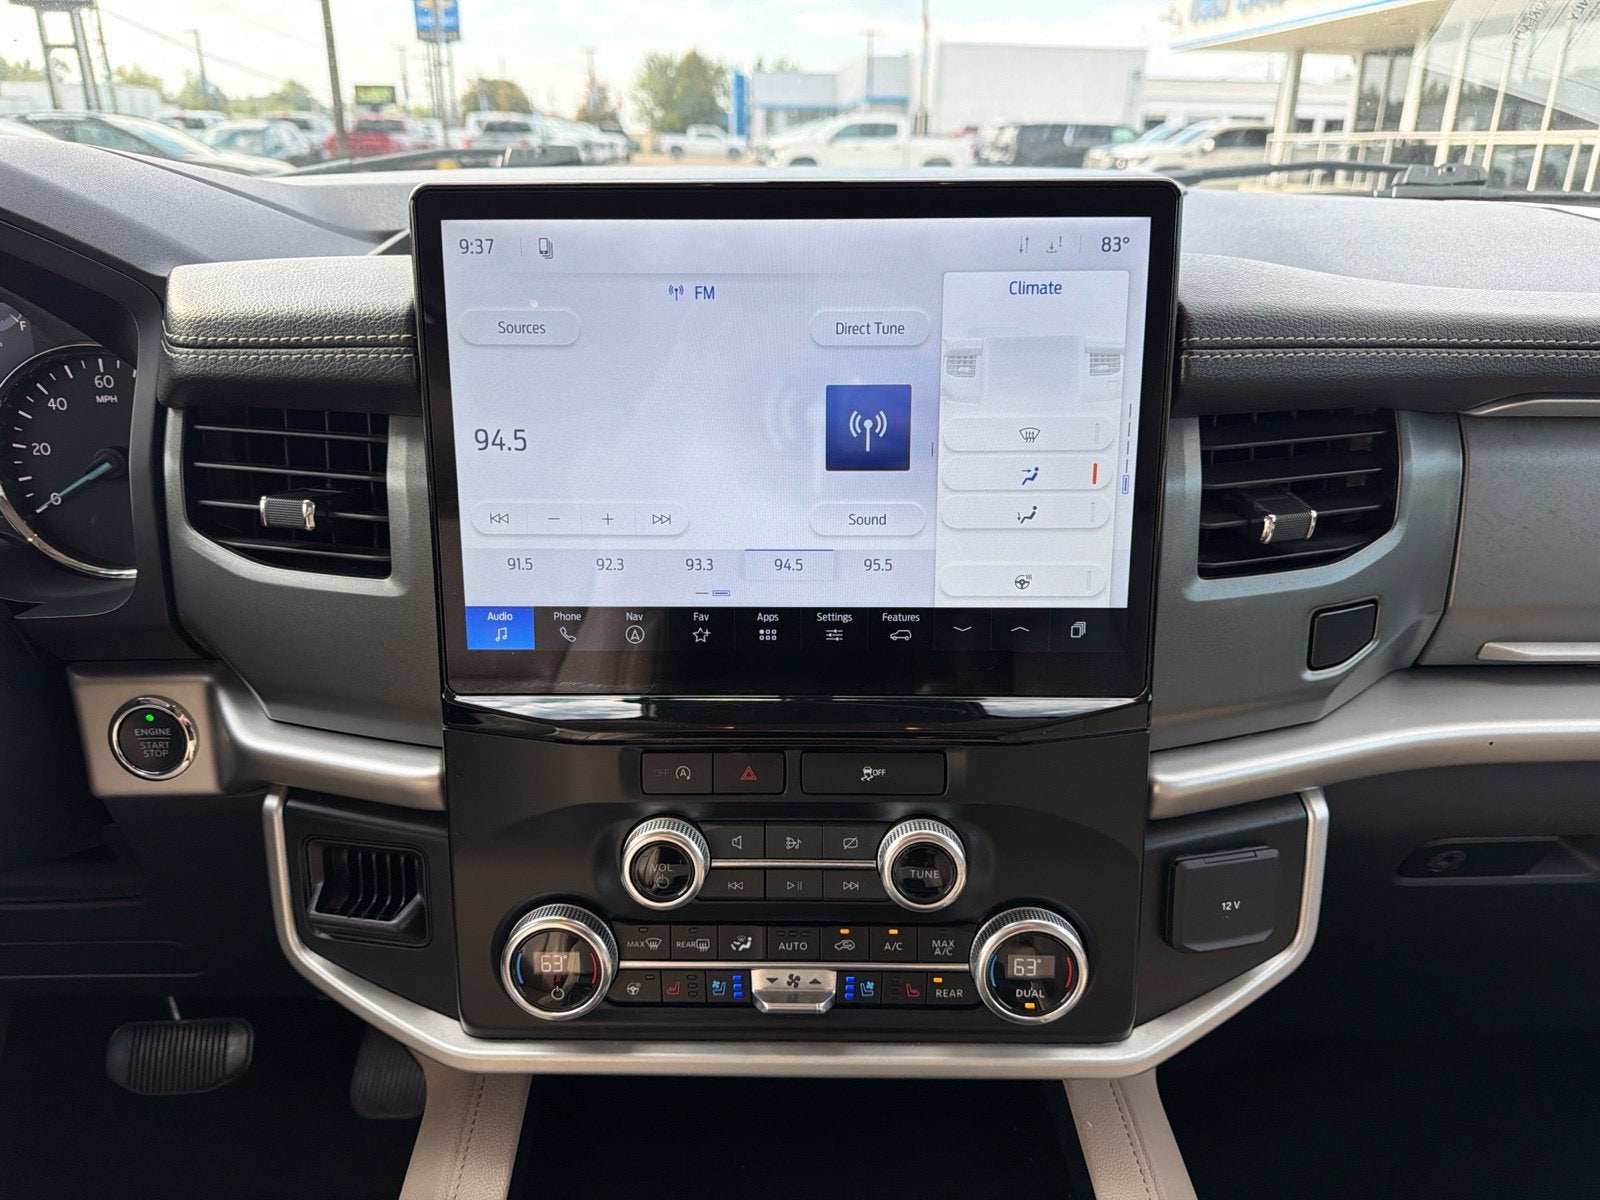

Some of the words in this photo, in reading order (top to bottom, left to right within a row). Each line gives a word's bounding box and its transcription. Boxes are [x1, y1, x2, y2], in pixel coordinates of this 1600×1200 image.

[460, 239, 493, 254] 9:37
[1102, 237, 1129, 252] 83°
[695, 286, 714, 299] FM
[1010, 281, 1062, 295] Climate
[20, 321, 26, 331] F
[498, 321, 545, 334] Sources
[836, 322, 871, 334] Direct
[874, 322, 904, 334] Tune
[95, 375, 114, 388] 60
[48, 398, 67, 410] 40
[475, 429, 526, 451] 94.5
[32, 443, 51, 455] 20
[50, 492, 62, 505] 0
[849, 514, 886, 525] Sound
[508, 558, 533, 570] 91.5
[597, 558, 624, 570] 92.3
[686, 558, 713, 570] 93.3
[775, 559, 803, 571] 94.5
[864, 559, 892, 571] 95.5
[488, 612, 513, 620] Audio
[554, 612, 581, 620] Phone
[626, 612, 643, 620] Nav
[694, 612, 709, 621] Fav
[756, 612, 779, 623] Apps
[816, 612, 853, 624] Settings
[883, 613, 920, 621] Features
[134, 728, 171, 736] ENGINE
[140, 741, 170, 750] START
[144, 750, 168, 758] STOP
[873, 768, 886, 777] OFF
[651, 863, 673, 873] VOL
[910, 870, 939, 879] TUNE
[627, 940, 646, 948] MAX
[676, 940, 697, 948] REAR
[779, 942, 807, 950] AUTO
[884, 942, 902, 951] A/C
[935, 947, 952, 955] A/C
[541, 953, 567, 972] 63°
[1014, 958, 1041, 976] 63°
[936, 989, 963, 997] REAR
[1015, 989, 1045, 998] DUAL
